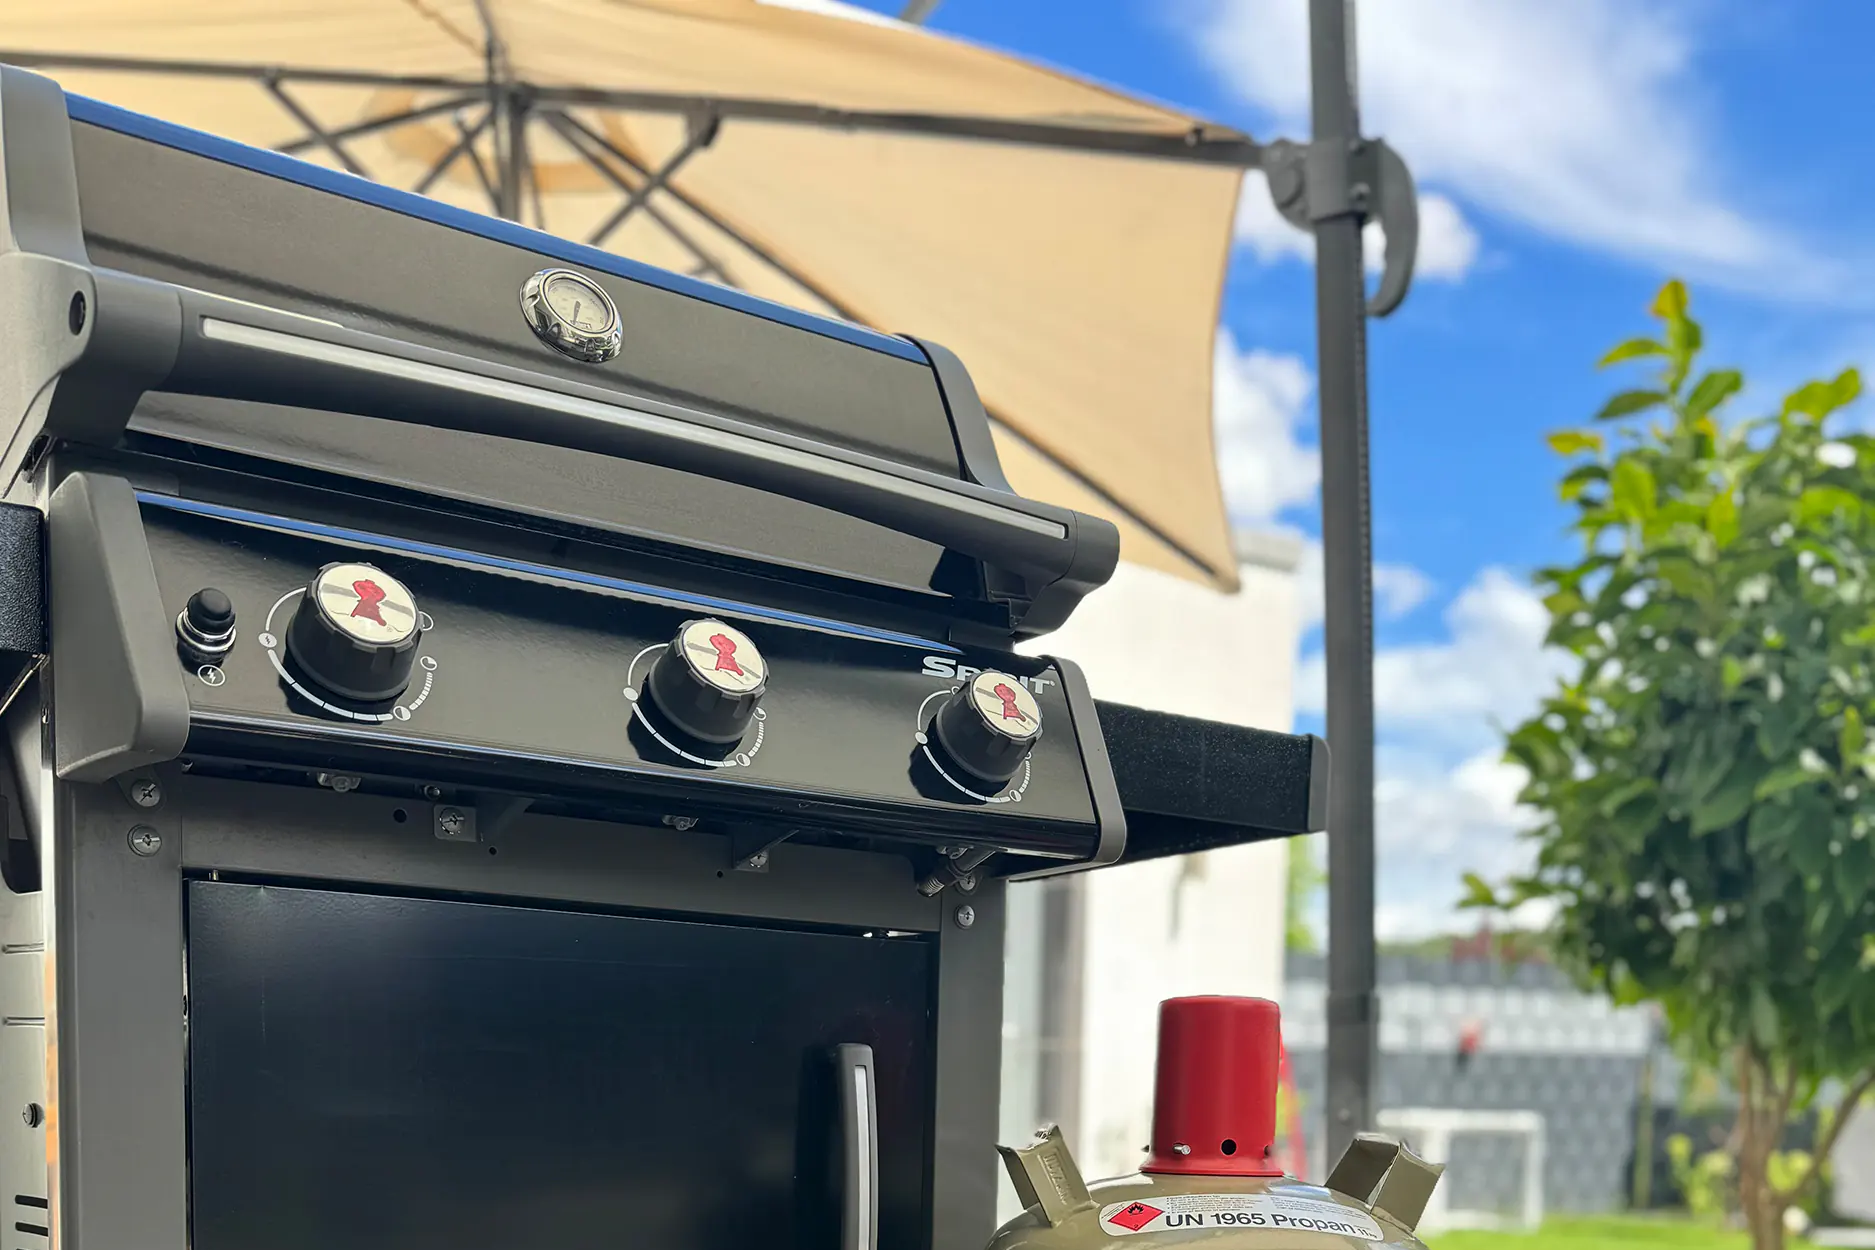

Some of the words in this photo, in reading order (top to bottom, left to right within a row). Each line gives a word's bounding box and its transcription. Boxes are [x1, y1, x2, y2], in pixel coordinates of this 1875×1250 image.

[922, 655, 1050, 695] SPIT
[1165, 1213, 1204, 1227] UN
[1210, 1212, 1266, 1226] 1965
[1270, 1213, 1357, 1235] Propan
